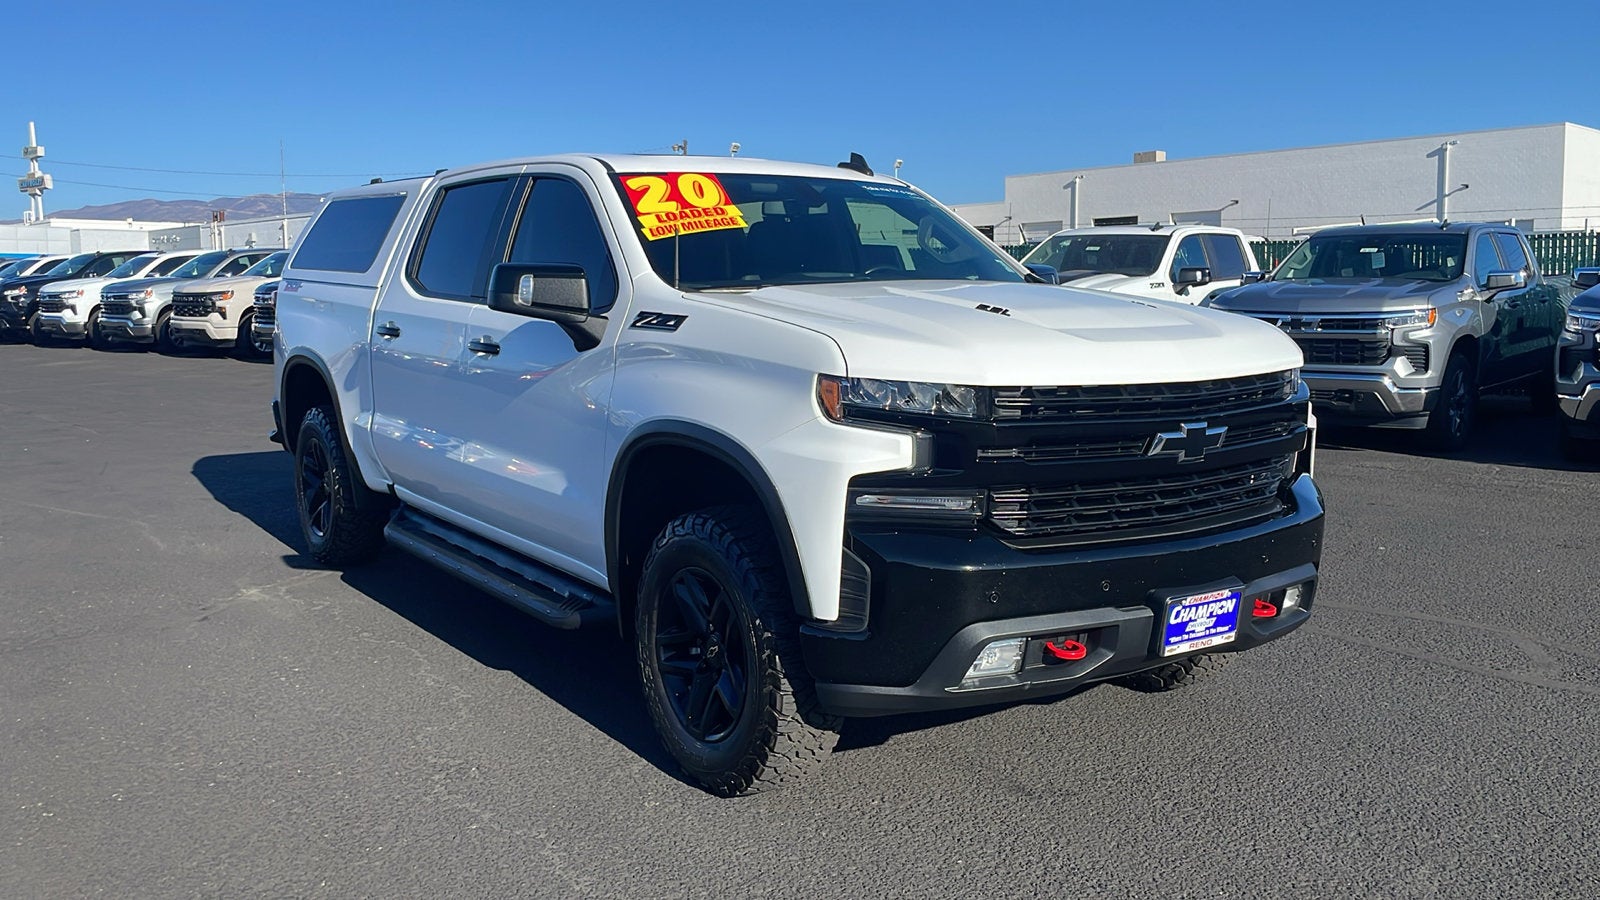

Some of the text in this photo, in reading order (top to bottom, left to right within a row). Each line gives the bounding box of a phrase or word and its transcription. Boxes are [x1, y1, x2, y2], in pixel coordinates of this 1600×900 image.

[626, 173, 725, 214] 20
[655, 207, 727, 223] LOADED
[649, 217, 739, 237] LOW MILEAGE
[1188, 592, 1226, 604] CHAMPION
[1170, 599, 1236, 624] CHAMPION
[1189, 639, 1213, 649] RENO
